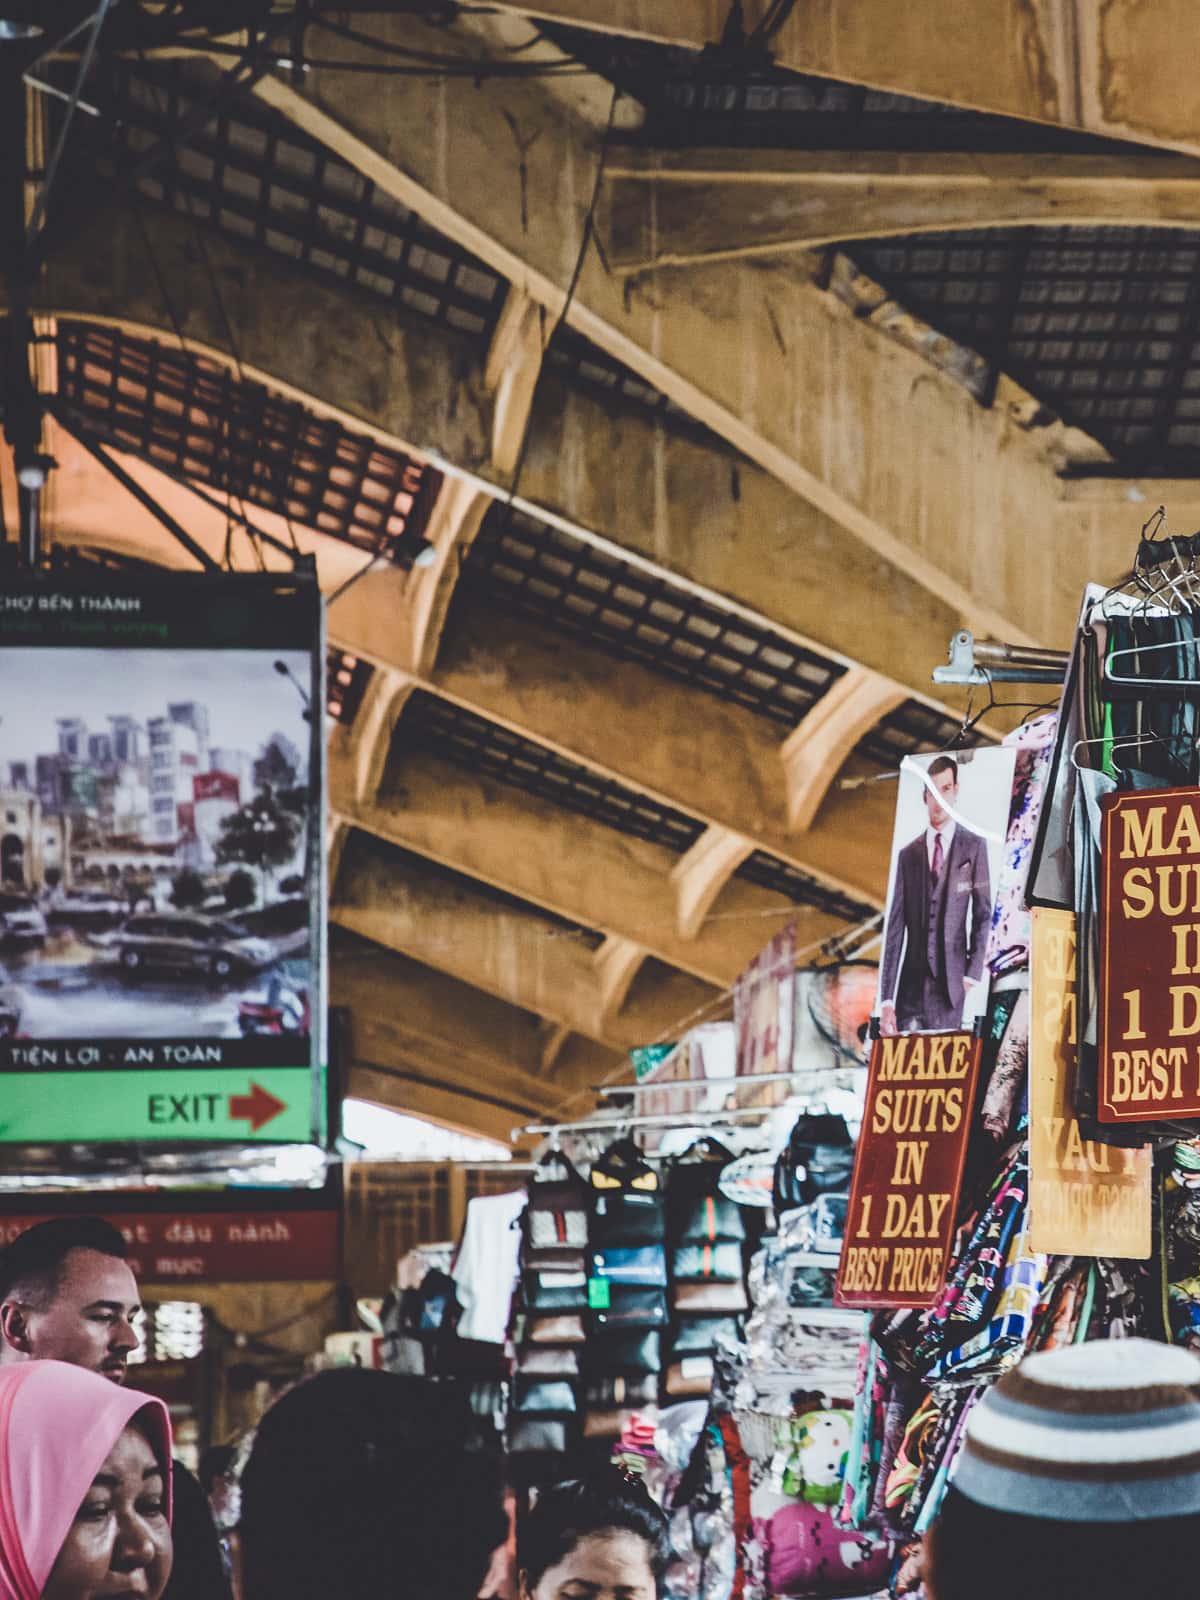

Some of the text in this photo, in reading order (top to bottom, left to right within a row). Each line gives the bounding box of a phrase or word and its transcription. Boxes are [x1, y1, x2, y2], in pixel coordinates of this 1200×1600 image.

[0, 596, 34, 613] HỢ
[1122, 989, 1147, 1040] 1
[124, 1047, 154, 1063] AN
[877, 1035, 972, 1082] MAKE
[1111, 1047, 1188, 1103] BEST
[148, 1094, 221, 1124] EXIT
[872, 1087, 964, 1135] SUITS
[891, 1141, 929, 1186] IN
[856, 1193, 952, 1239] 1 DAY
[842, 1247, 943, 1293] BEST PRICE
